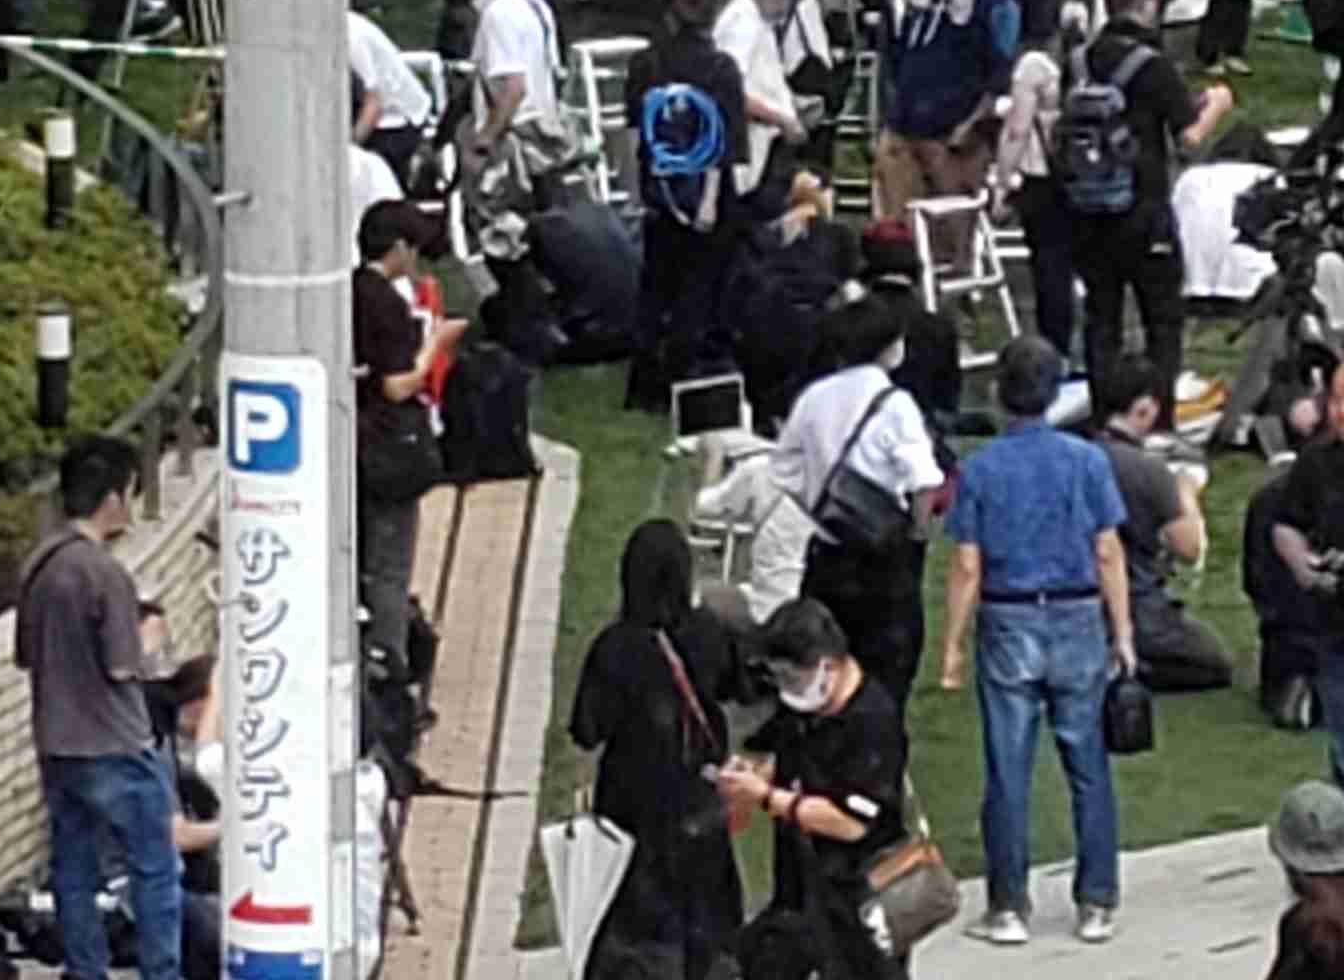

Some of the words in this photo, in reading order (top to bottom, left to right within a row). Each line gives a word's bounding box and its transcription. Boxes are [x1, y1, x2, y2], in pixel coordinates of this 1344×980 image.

[232, 390, 288, 464] P
[237, 527, 292, 873] サンワシティ
